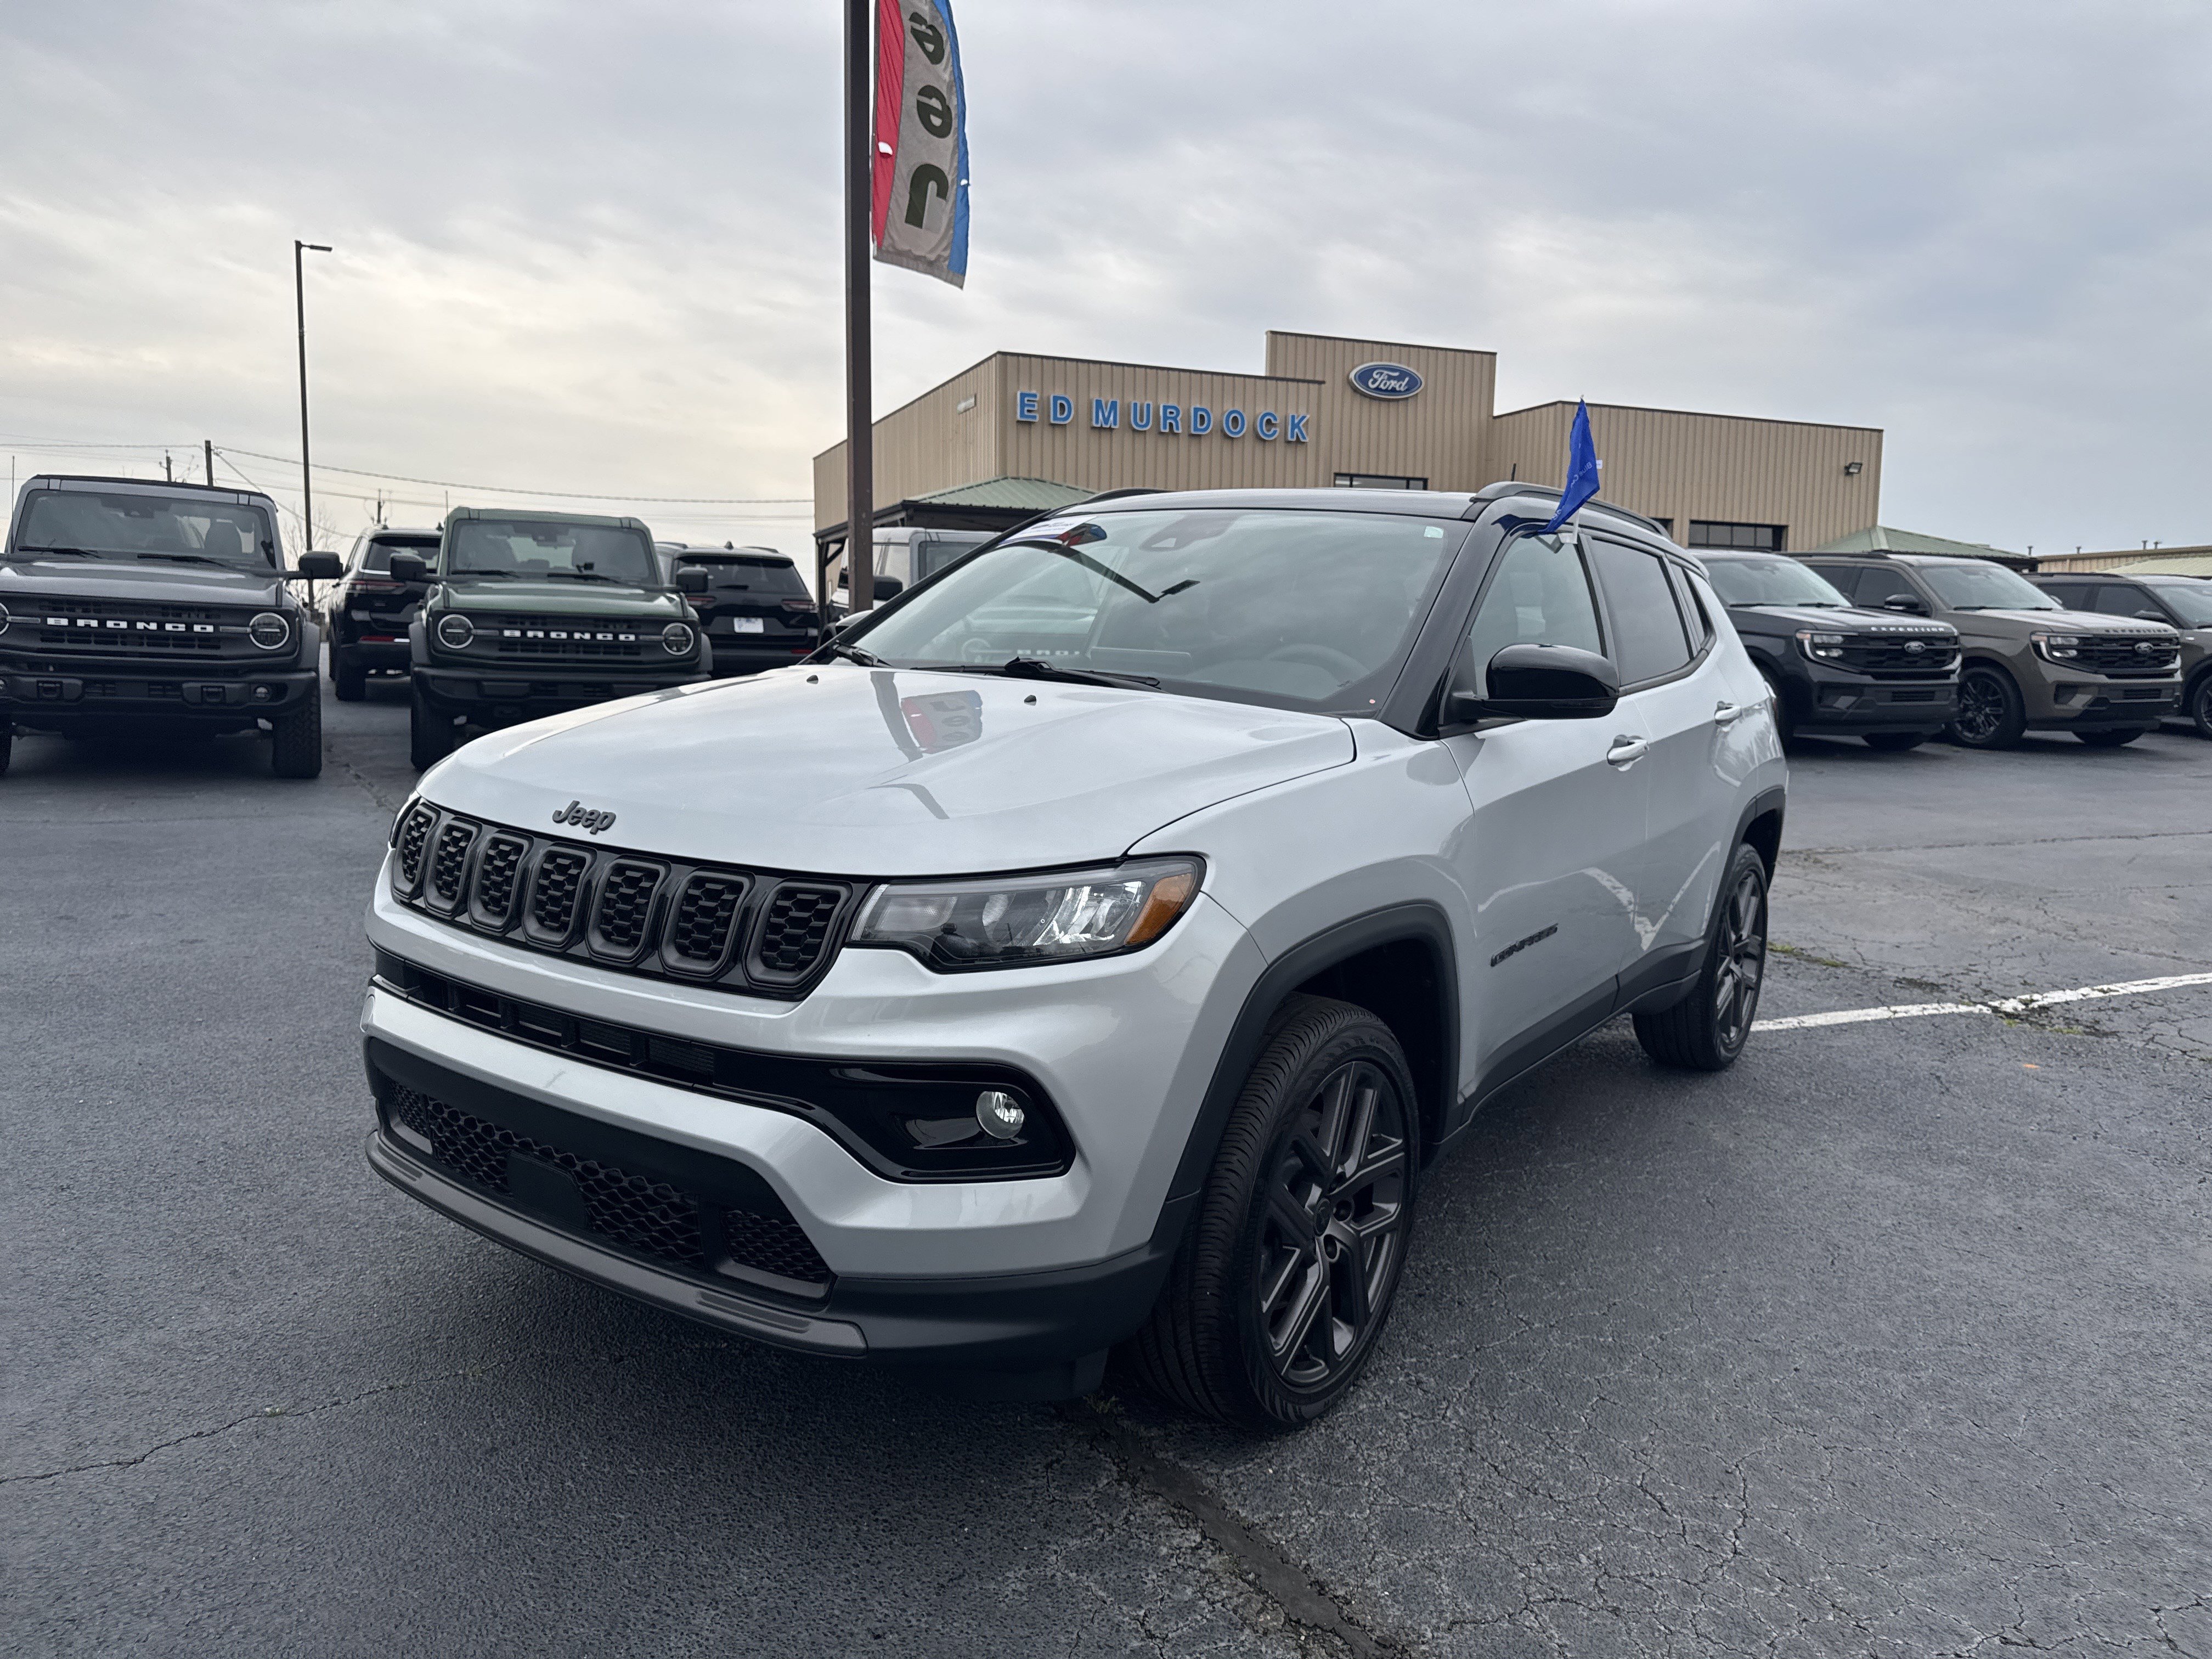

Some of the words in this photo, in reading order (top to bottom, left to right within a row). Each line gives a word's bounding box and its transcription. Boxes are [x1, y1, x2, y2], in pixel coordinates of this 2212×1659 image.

[1368, 369, 1409, 392] Ford
[1017, 390, 1074, 425] ED
[1092, 398, 1310, 442] MURDOCK
[47, 617, 213, 633] BRONCO
[504, 629, 635, 641] BRONCO
[552, 800, 616, 835] Jeep
